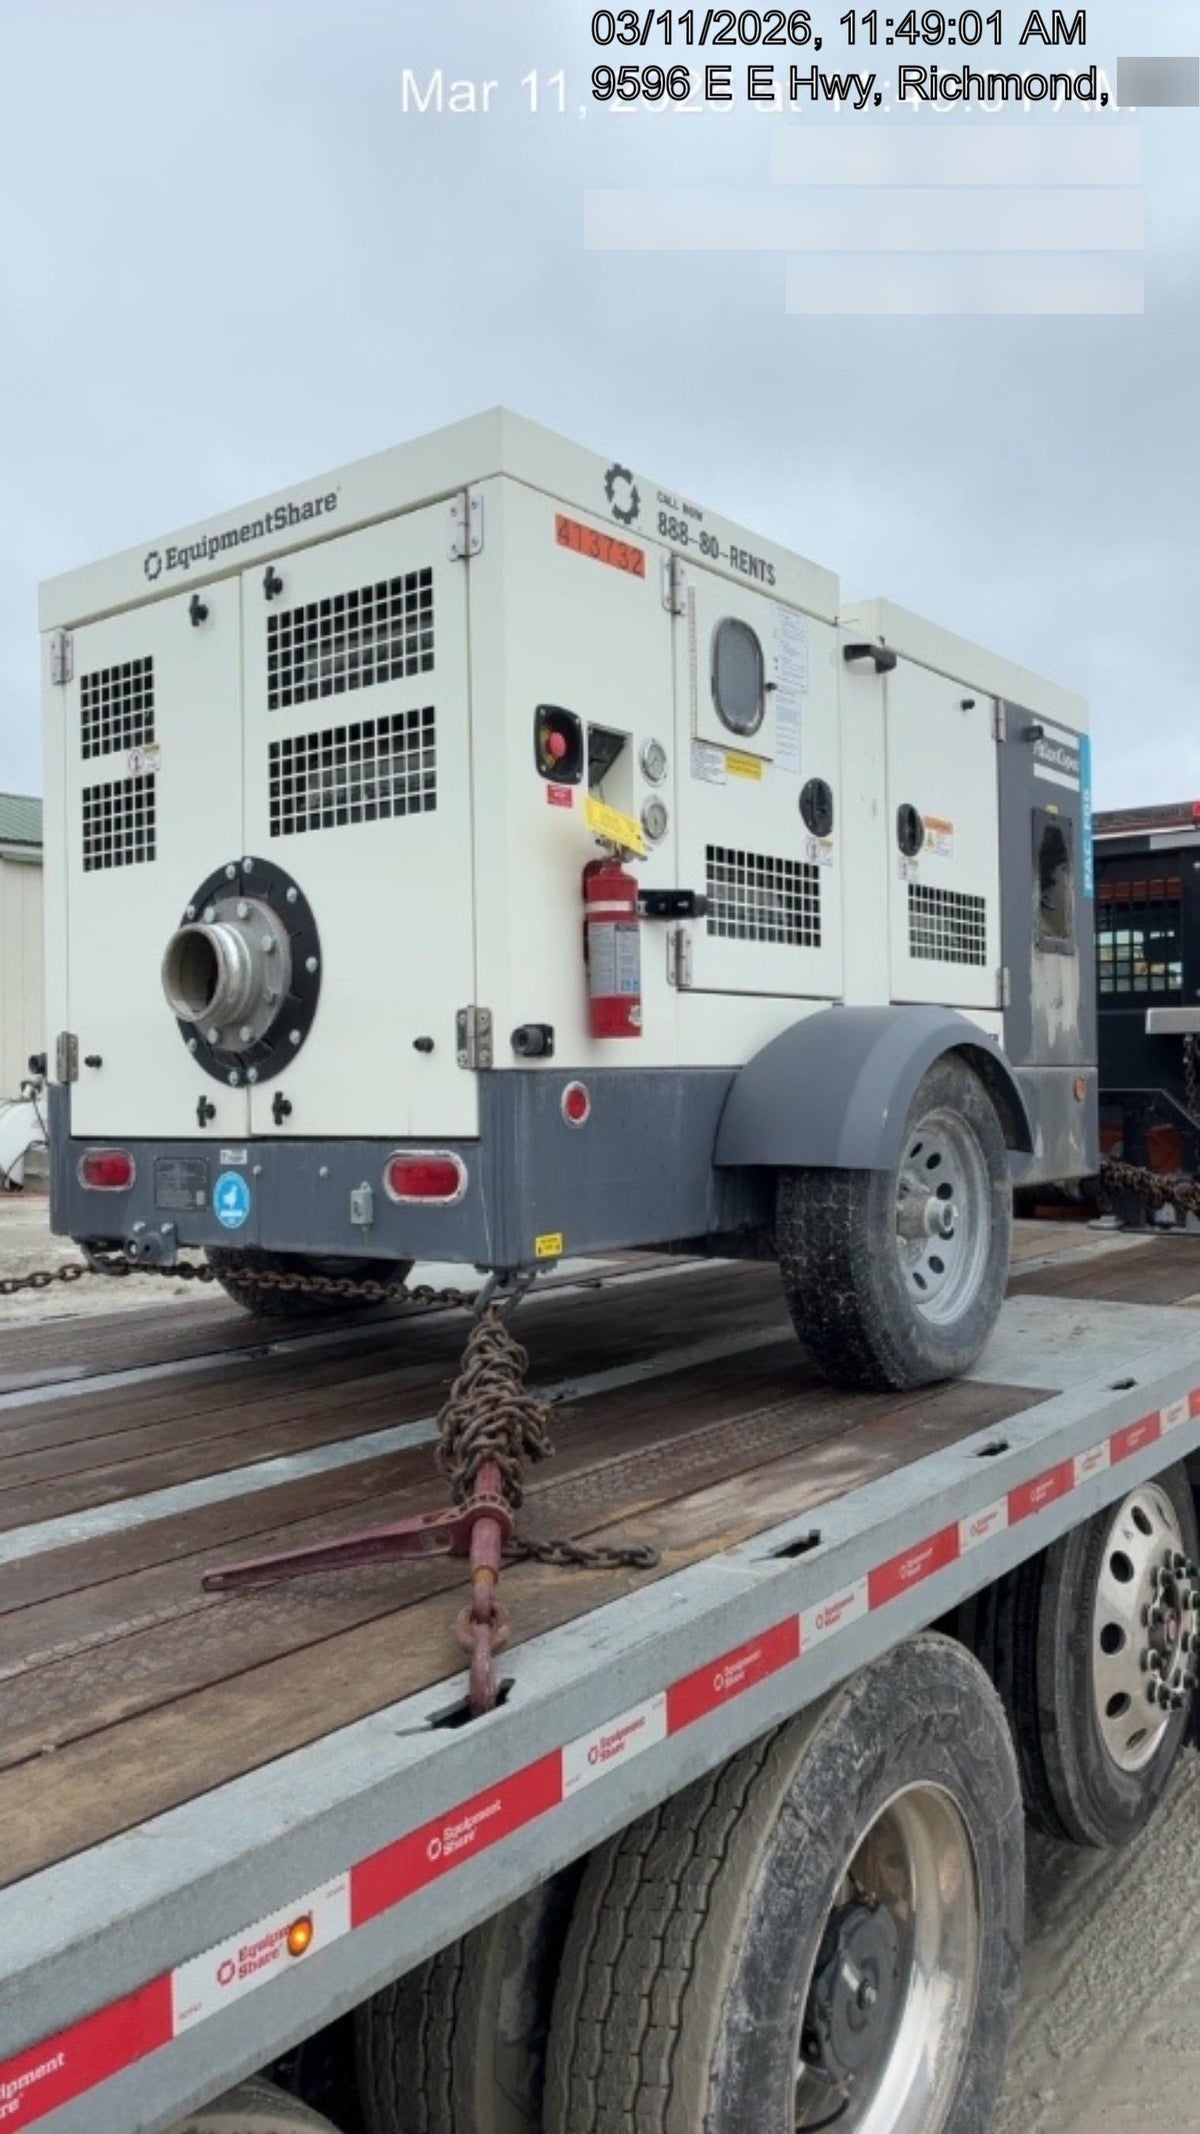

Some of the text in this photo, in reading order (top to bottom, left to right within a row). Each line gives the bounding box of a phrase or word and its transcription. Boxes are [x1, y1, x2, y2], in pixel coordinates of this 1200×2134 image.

[165, 492, 338, 570] EquipmentShare
[658, 511, 776, 587] 888-80-RENTS
[239, 1948, 281, 1979] Share
